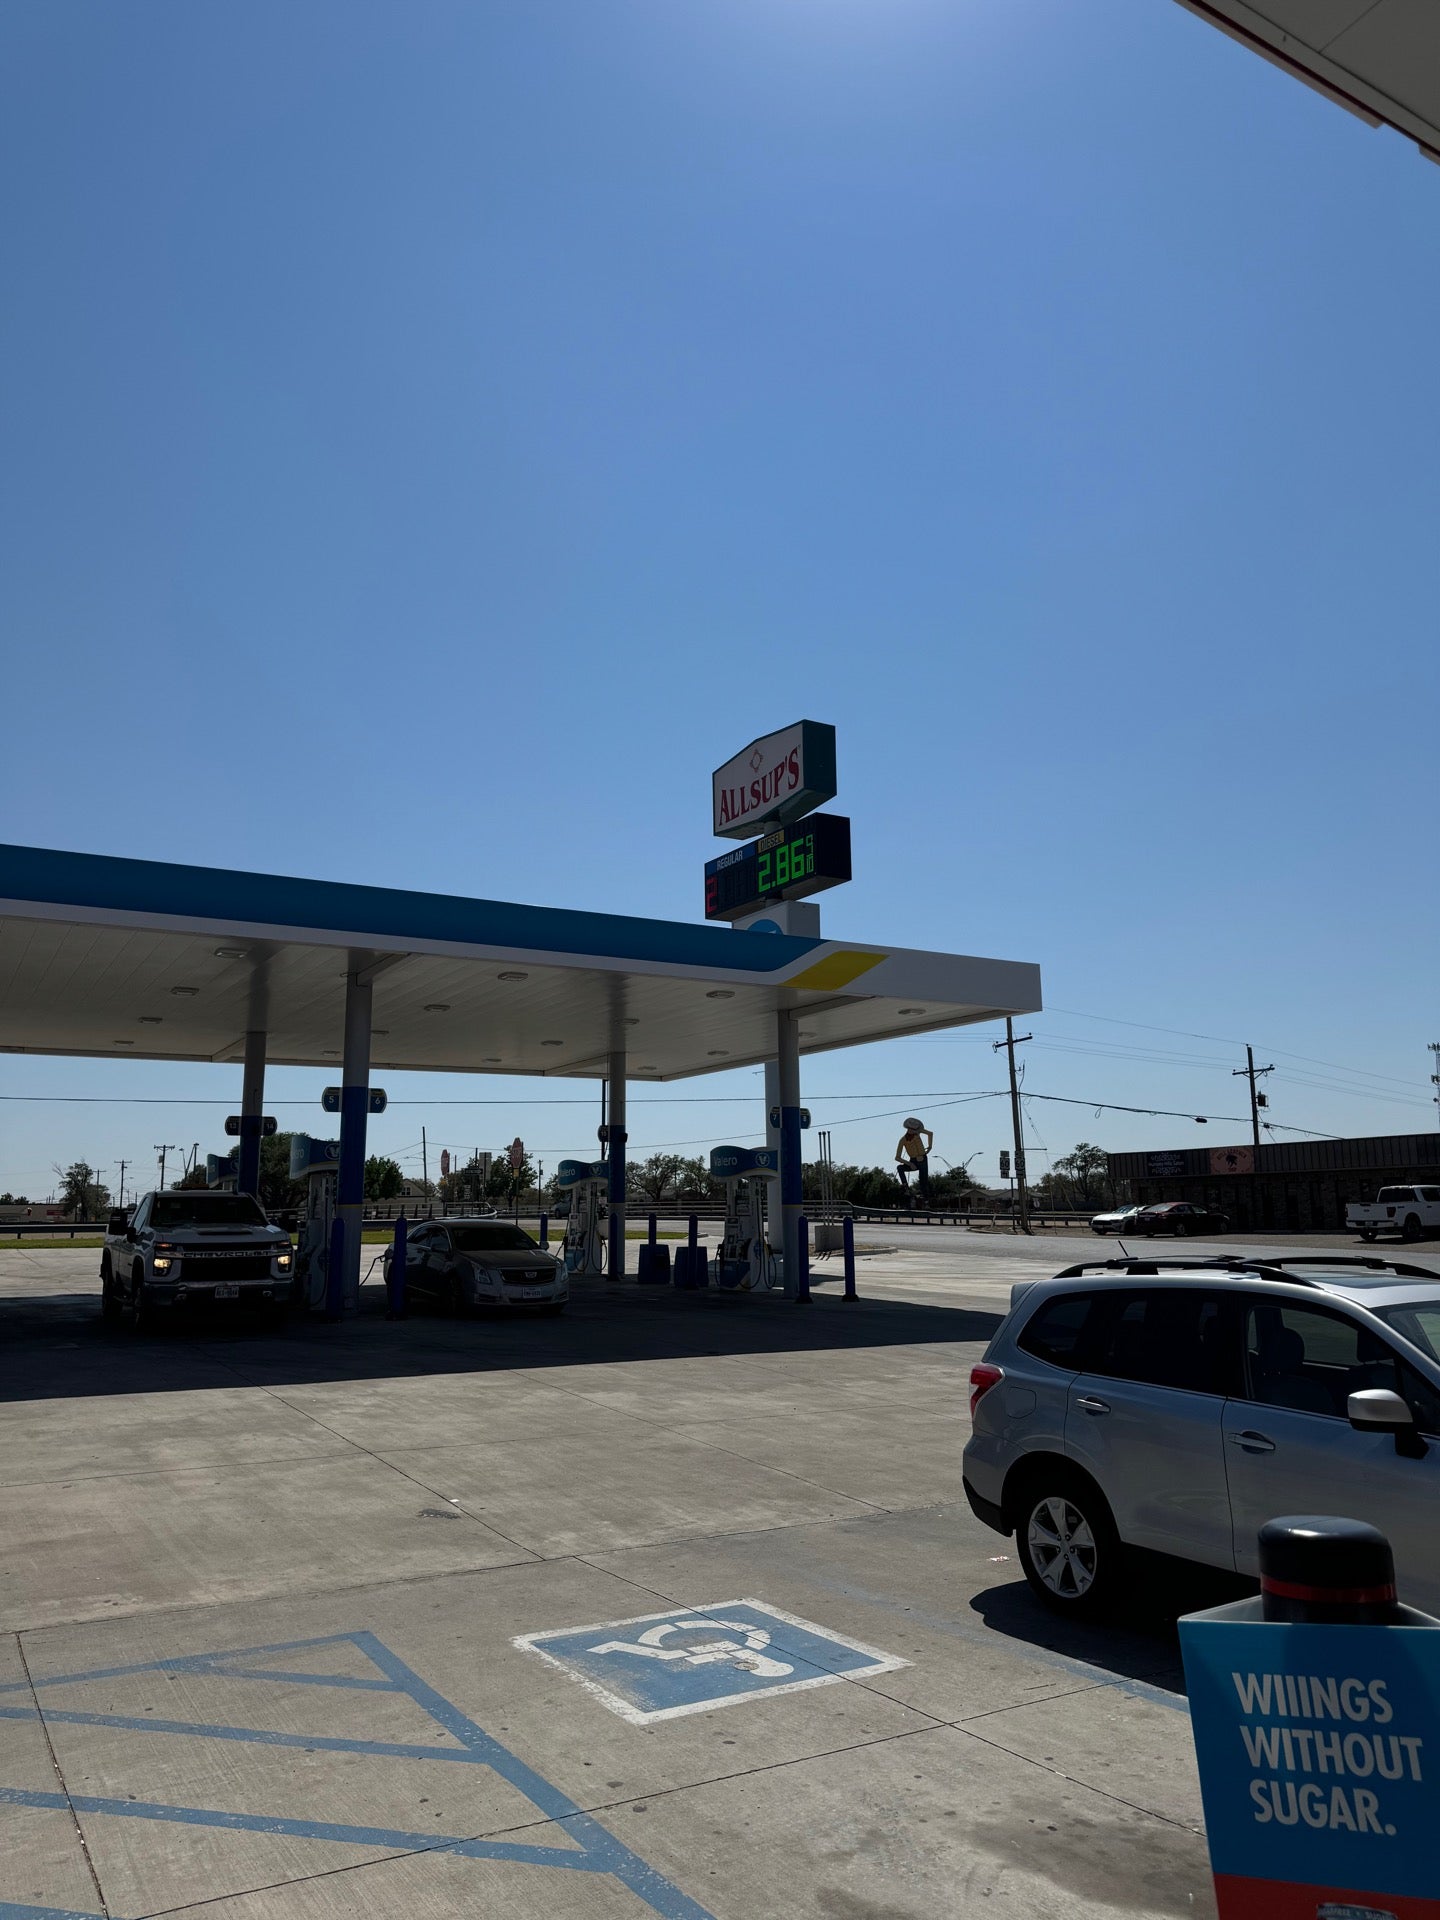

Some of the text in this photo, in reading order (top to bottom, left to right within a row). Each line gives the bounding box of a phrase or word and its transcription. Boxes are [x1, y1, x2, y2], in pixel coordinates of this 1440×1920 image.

[719, 748, 800, 826] ALLSUP'S
[717, 850, 744, 870] REGULAR
[758, 838, 805, 893] 2.86
[761, 833, 781, 850] DIESEL
[713, 1155, 738, 1166] Valero
[184, 1250, 269, 1258] CHEVROLET
[1232, 1672, 1393, 1723] WIIINGS
[1239, 1725, 1423, 1781] WITHOUT
[1250, 1779, 1397, 1836] SUGAR.
